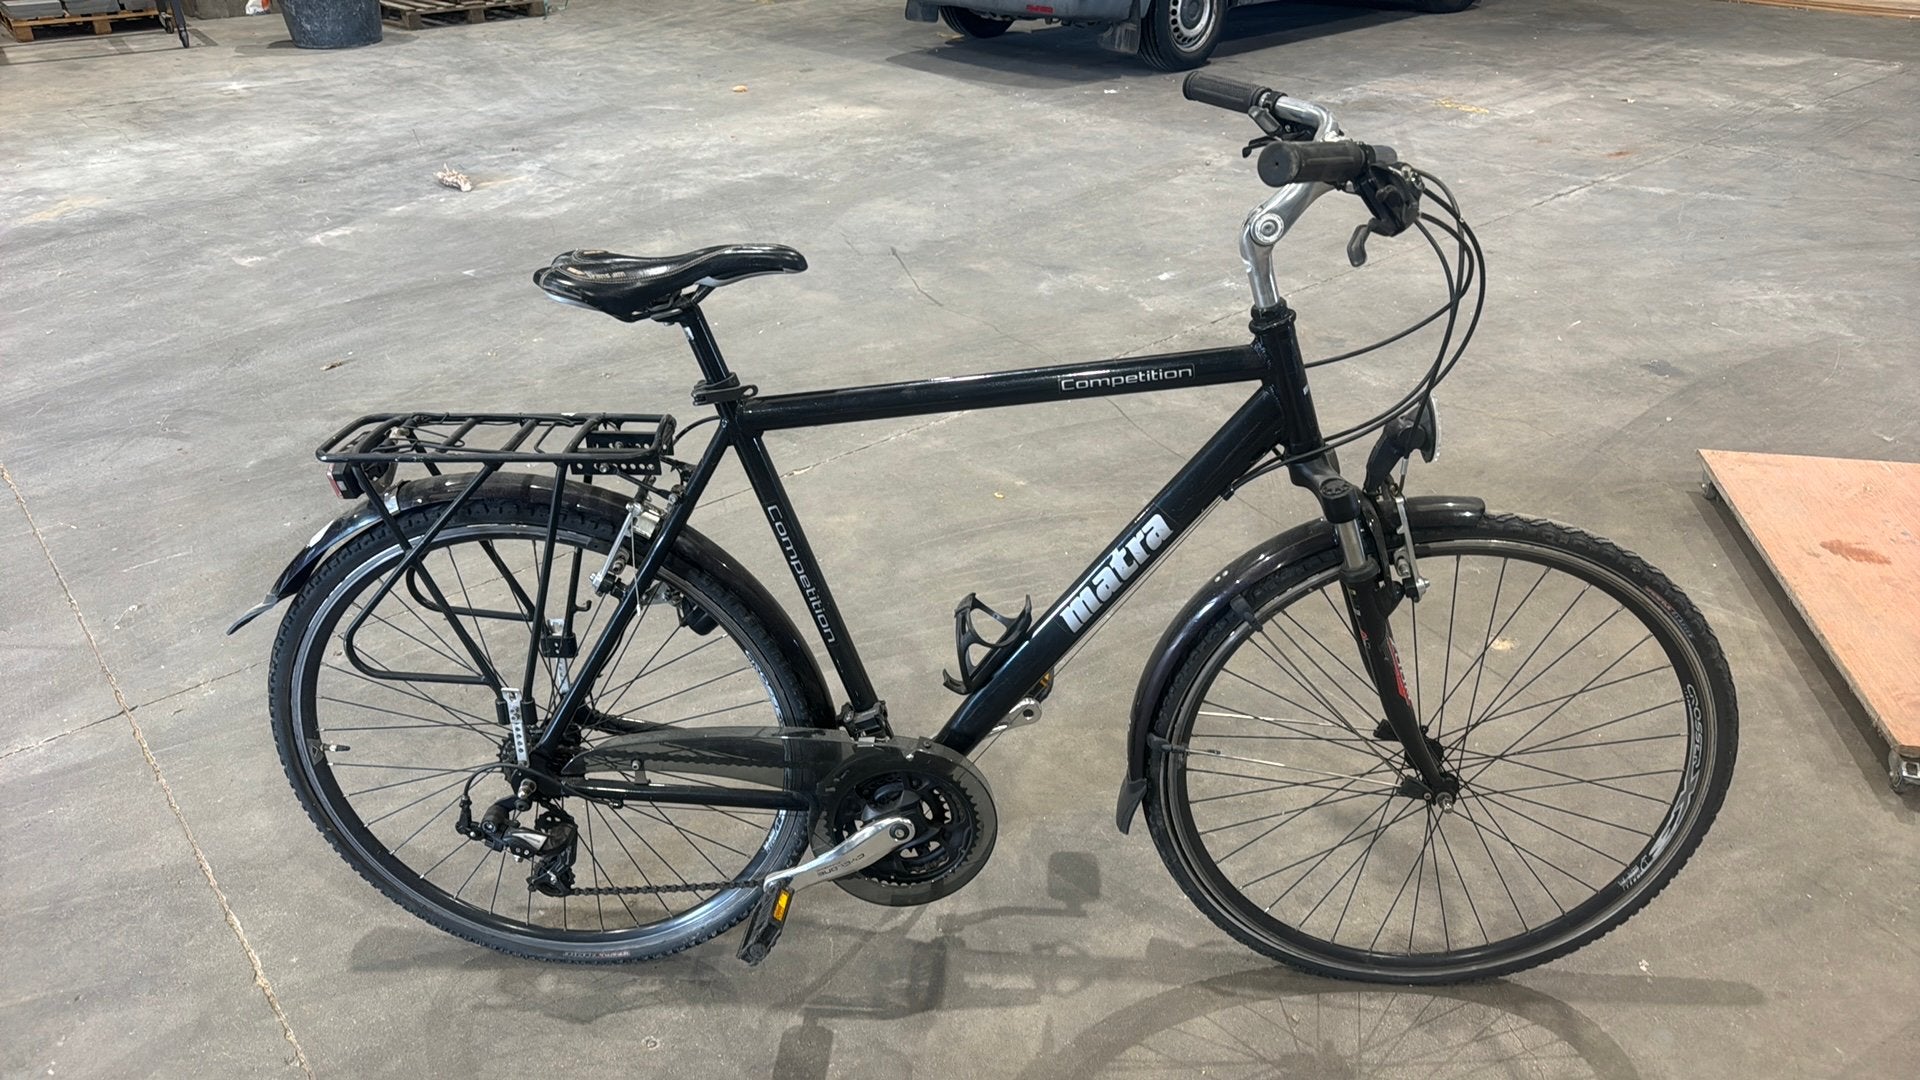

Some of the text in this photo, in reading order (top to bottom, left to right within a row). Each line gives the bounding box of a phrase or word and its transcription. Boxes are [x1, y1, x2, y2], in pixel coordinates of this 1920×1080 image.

[1060, 367, 1193, 391] Competition
[767, 504, 836, 644] Competition
[1059, 513, 1175, 634] matra
